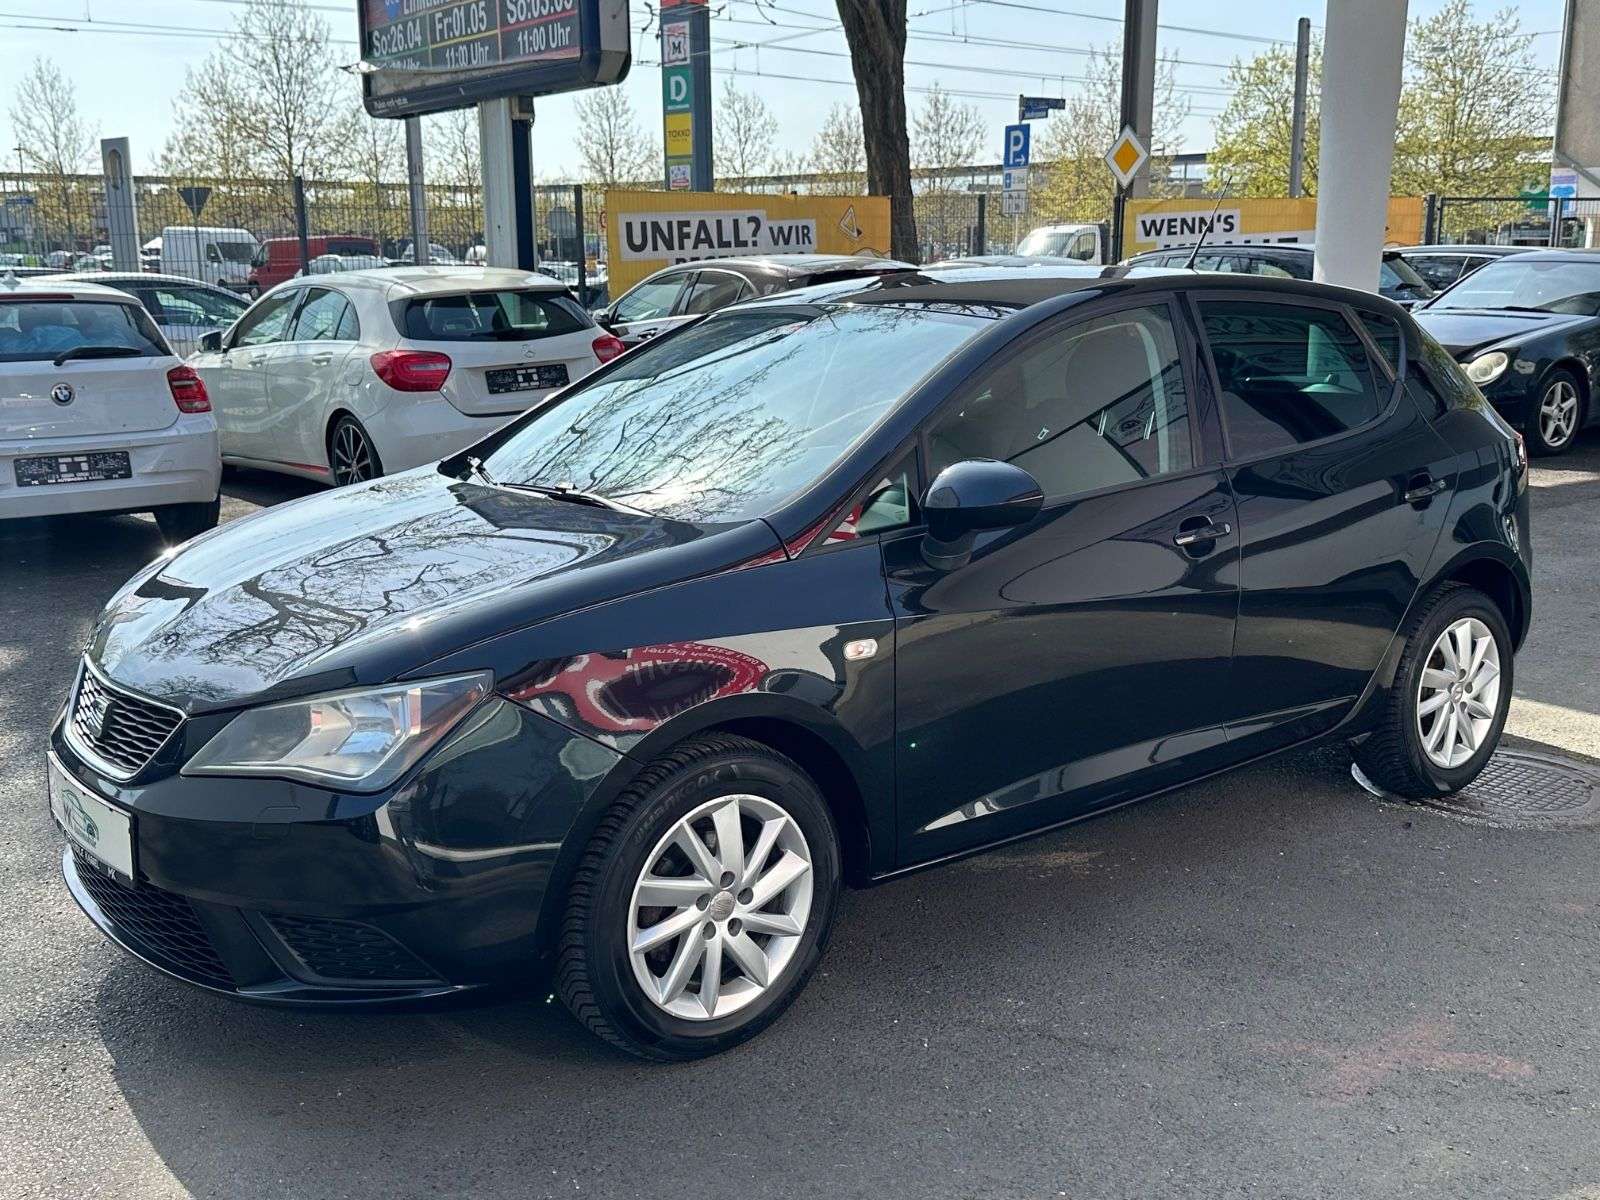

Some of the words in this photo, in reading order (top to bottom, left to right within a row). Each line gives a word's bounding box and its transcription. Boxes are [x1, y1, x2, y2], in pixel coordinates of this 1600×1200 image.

[372, 18, 422, 57] So:26.04
[435, 1, 487, 41] Fr:01.05
[470, 41, 489, 66] Uhr
[517, 27, 546, 56] 11:00
[548, 22, 571, 48] Uhr
[671, 40, 682, 55] M
[669, 75, 688, 102] D
[1009, 130, 1024, 165] P
[625, 216, 761, 253] UNFALL?
[768, 224, 812, 246] WIR
[1140, 214, 1235, 238] WENN'S
